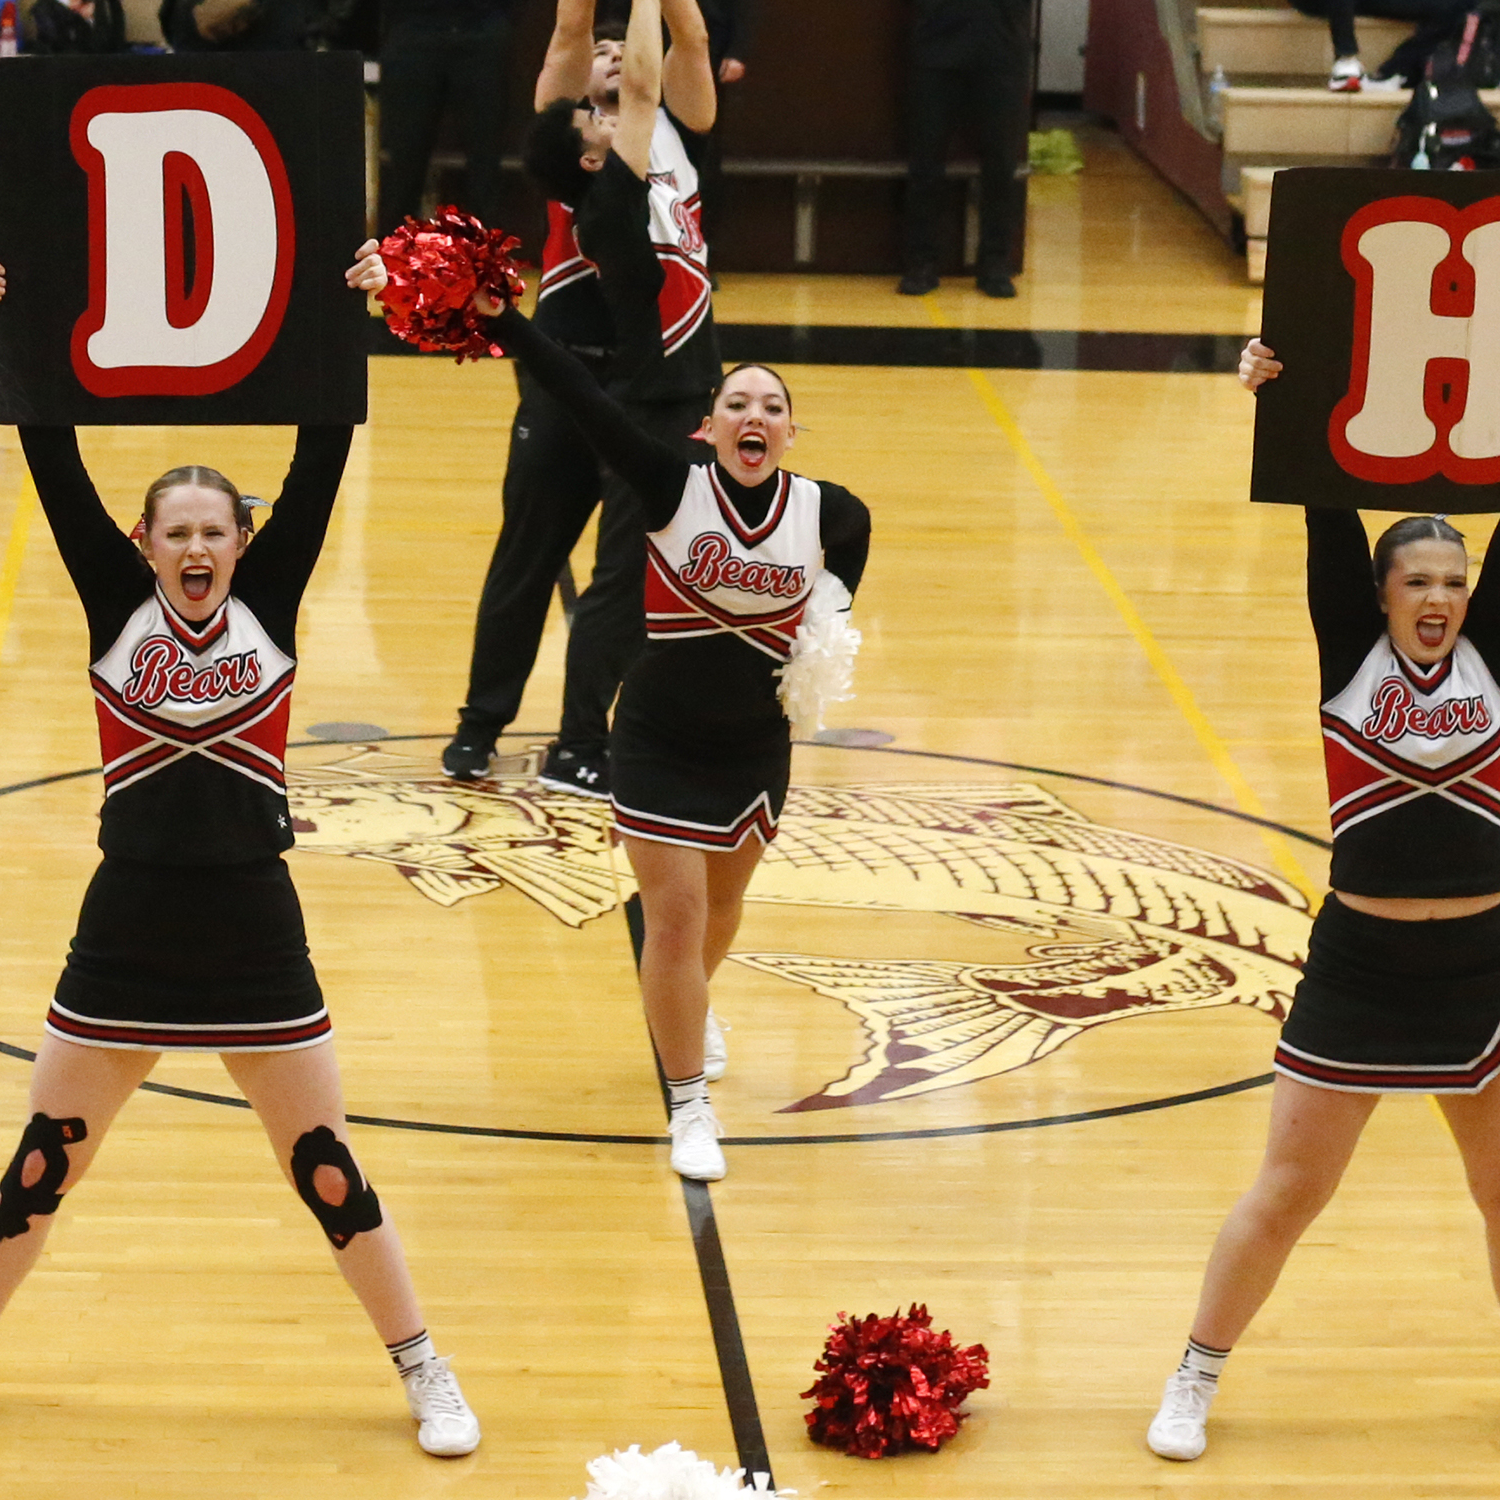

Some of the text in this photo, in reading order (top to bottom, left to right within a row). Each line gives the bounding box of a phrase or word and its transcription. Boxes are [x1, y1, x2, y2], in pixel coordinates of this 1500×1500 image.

[70, 82, 295, 397] D
[680, 532, 806, 598] Bears
[123, 633, 262, 708] Bears
[1363, 676, 1491, 742] Bears
